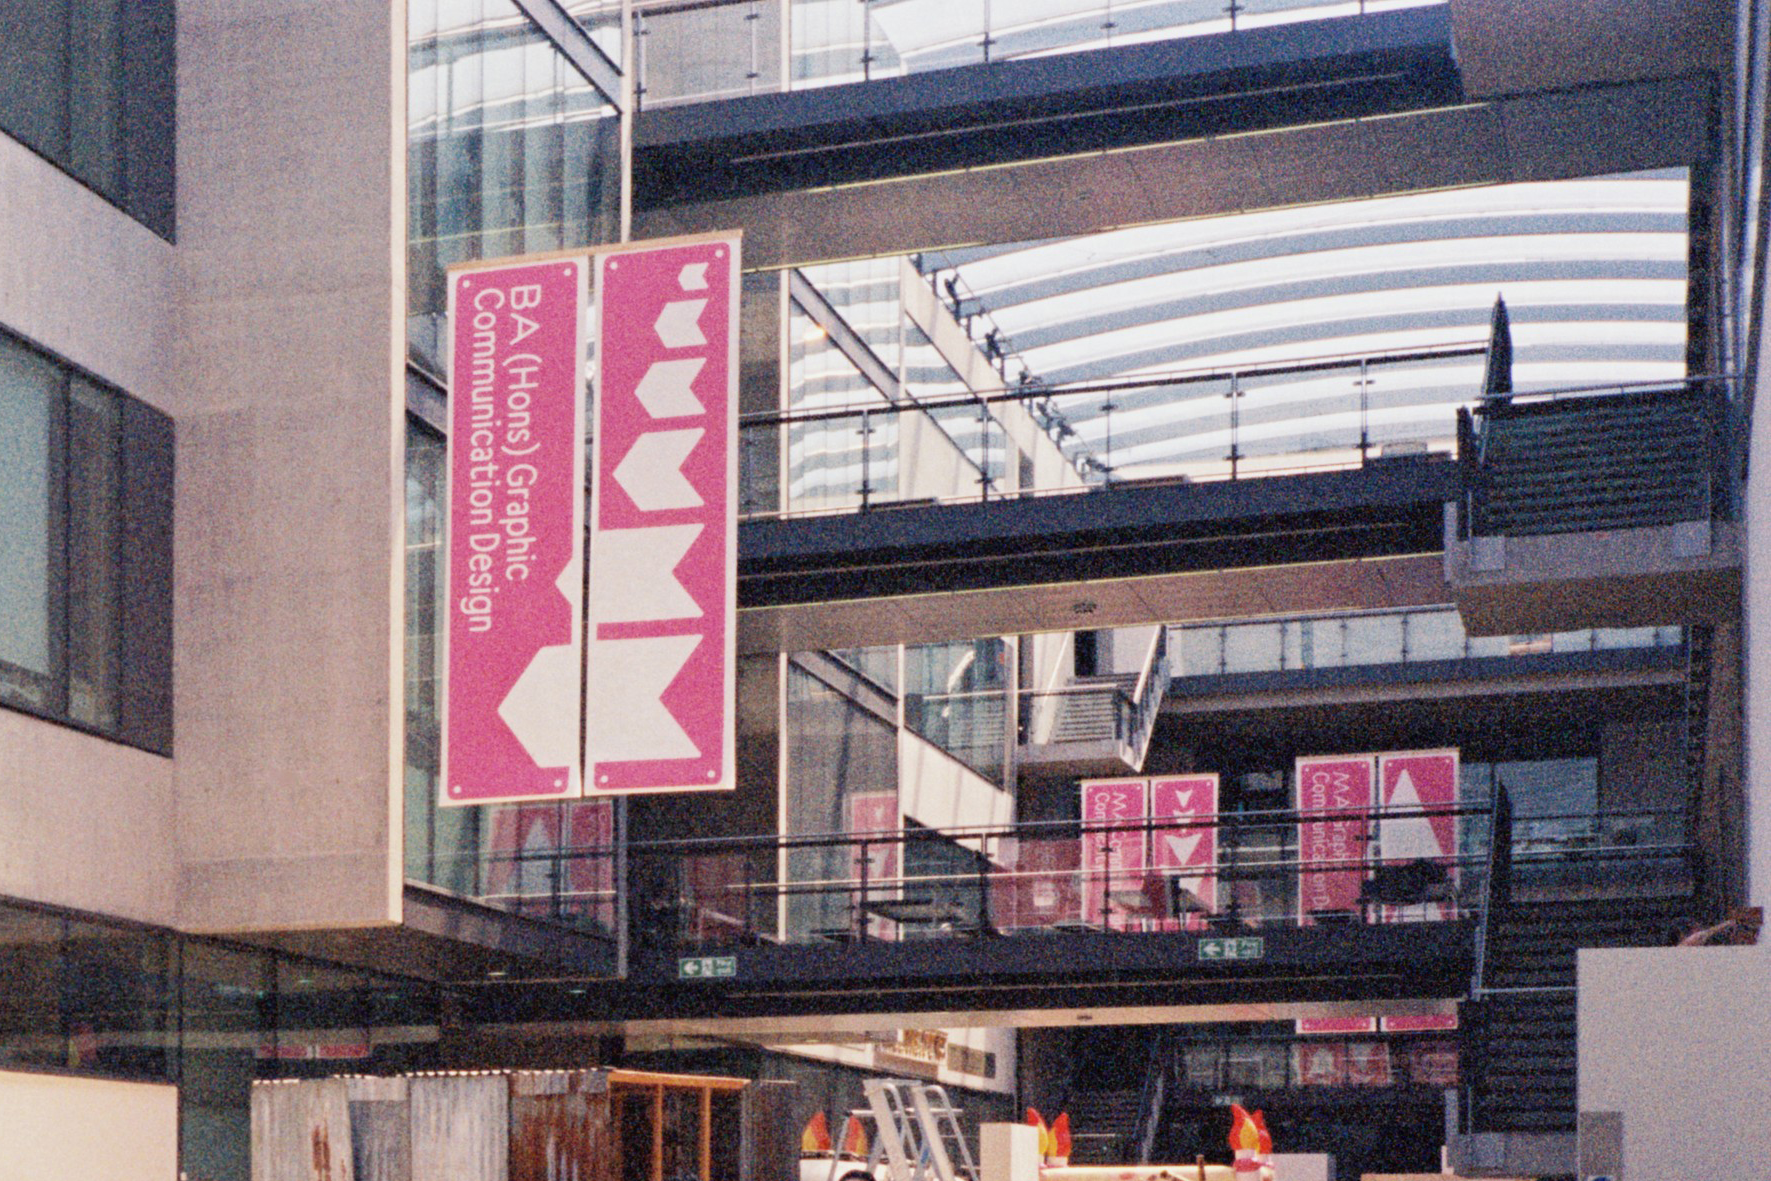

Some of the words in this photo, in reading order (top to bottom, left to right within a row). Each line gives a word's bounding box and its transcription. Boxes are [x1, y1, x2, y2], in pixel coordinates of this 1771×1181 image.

[509, 284, 542, 346] BA
[469, 288, 505, 525] Communication
[501, 353, 543, 456] (Hons)
[498, 463, 538, 581] Graphic
[460, 533, 501, 633] Design
[1332, 771, 1350, 811] MA
